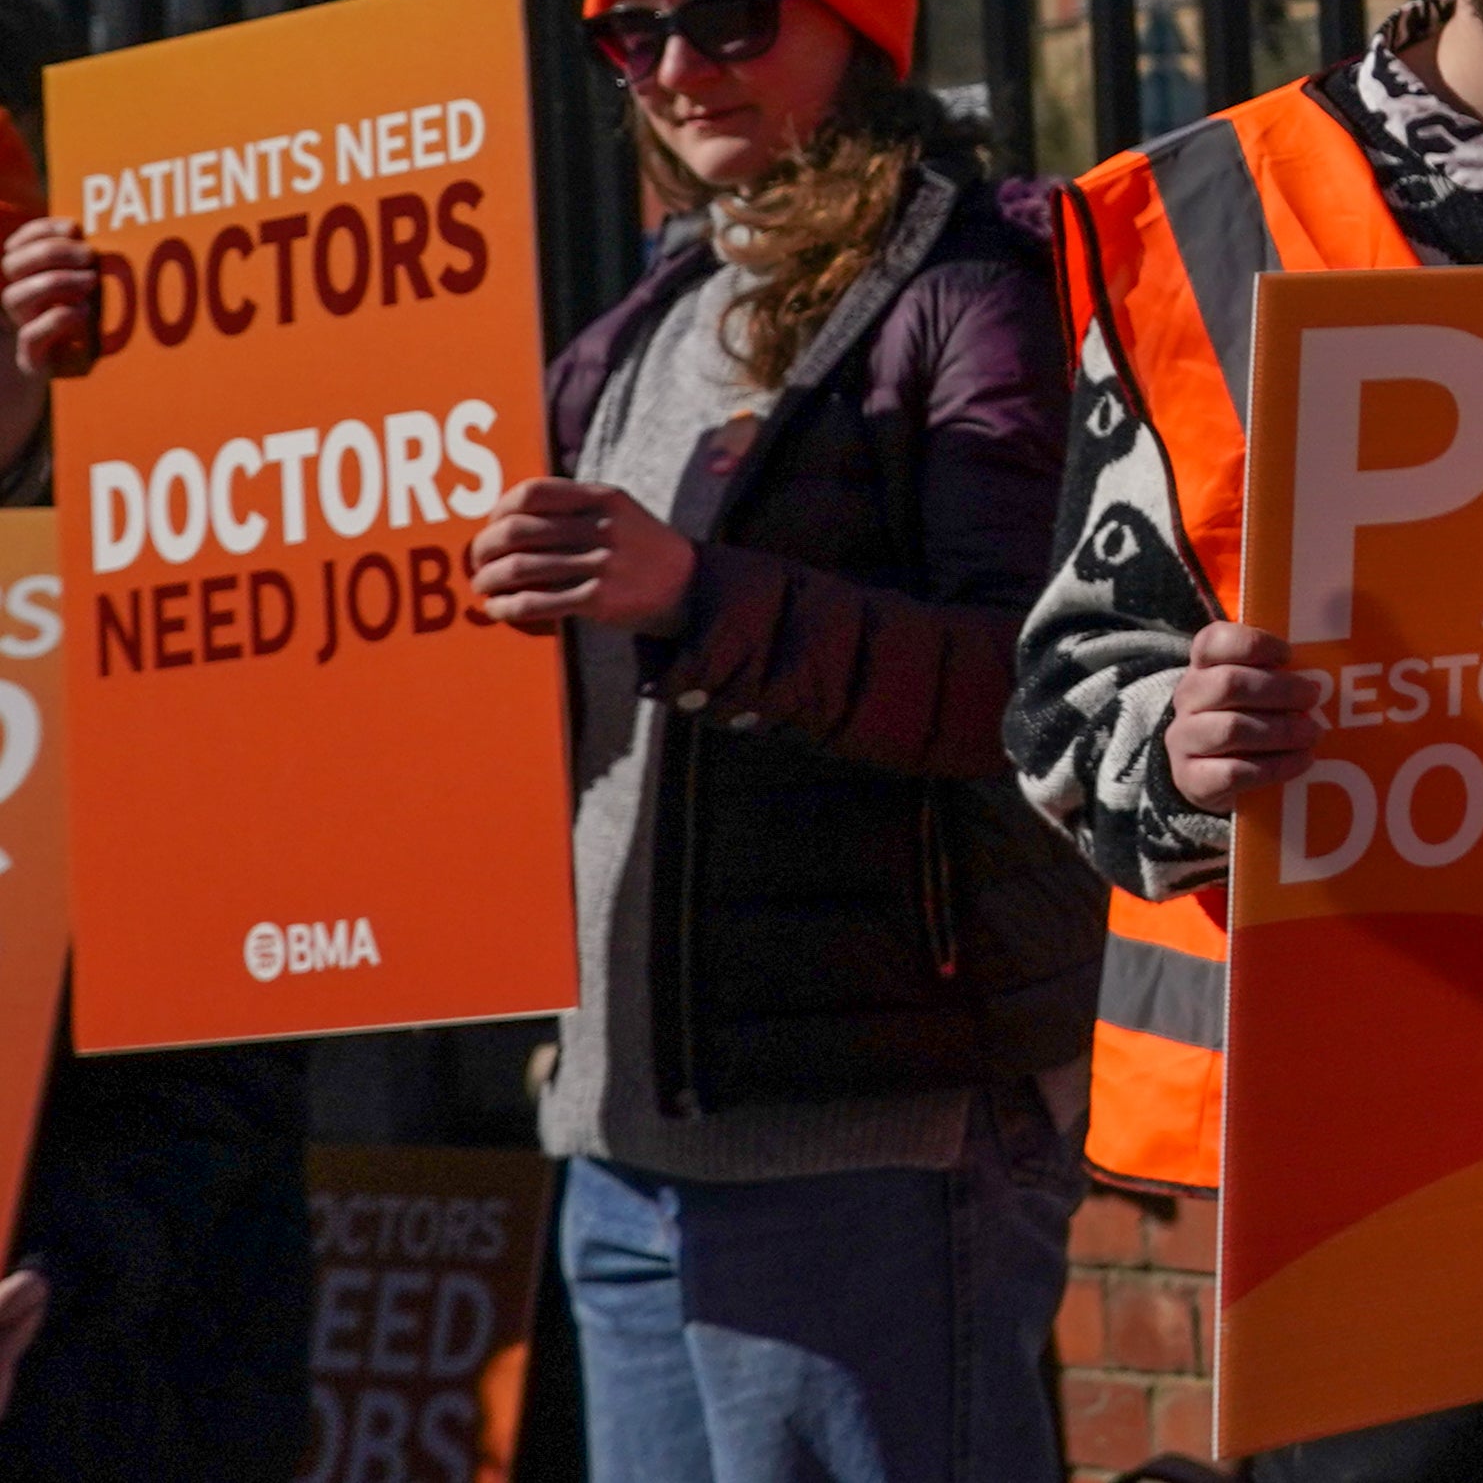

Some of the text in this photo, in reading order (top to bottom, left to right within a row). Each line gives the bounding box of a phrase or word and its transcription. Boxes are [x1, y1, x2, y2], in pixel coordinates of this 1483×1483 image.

[82, 98, 486, 235] PATIENTS NEED
[98, 179, 489, 359] DOCTORS
[89, 398, 504, 575] DOCTORS
[96, 569, 296, 678] NEED
[286, 917, 381, 975] BMA
